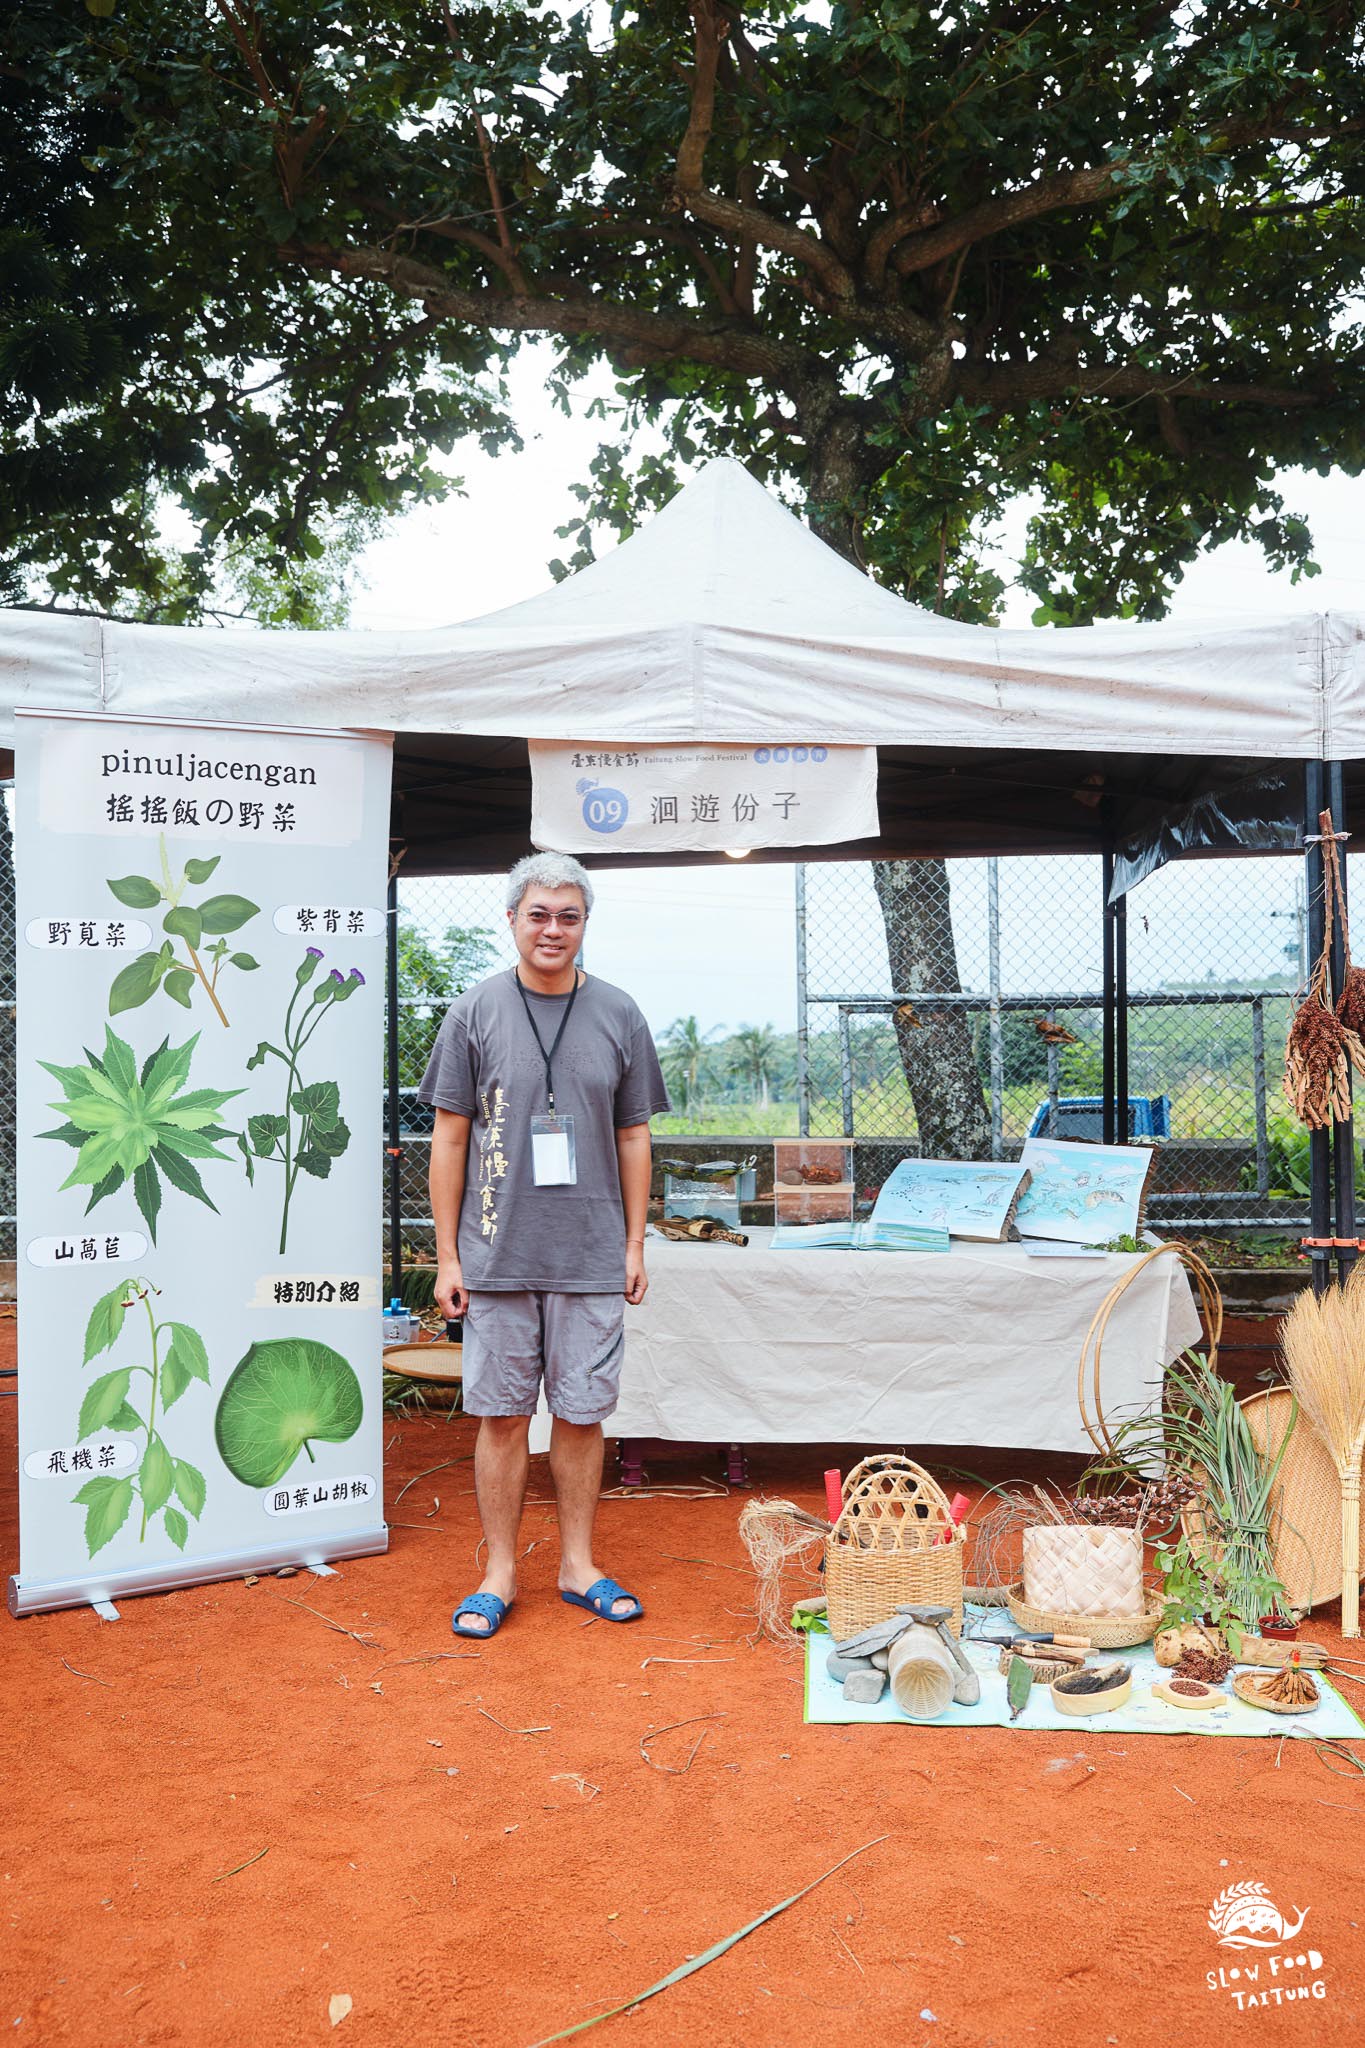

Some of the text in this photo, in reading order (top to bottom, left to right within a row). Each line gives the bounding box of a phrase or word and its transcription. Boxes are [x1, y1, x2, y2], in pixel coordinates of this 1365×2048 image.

[101, 749, 317, 787] pinuljacengan
[695, 753, 715, 762] Food
[716, 753, 748, 761] Festival
[106, 793, 297, 833] 搖搖飯の野菜
[589, 800, 622, 824] 09
[651, 792, 801, 825] 洄遊份子
[48, 921, 126, 947] 野莧菜
[296, 908, 366, 934] 紫背菜
[273, 1280, 360, 1304] 特別介紹
[48, 1445, 117, 1474] 飛機菜
[274, 1481, 369, 1511] 圓葉山胡椒
